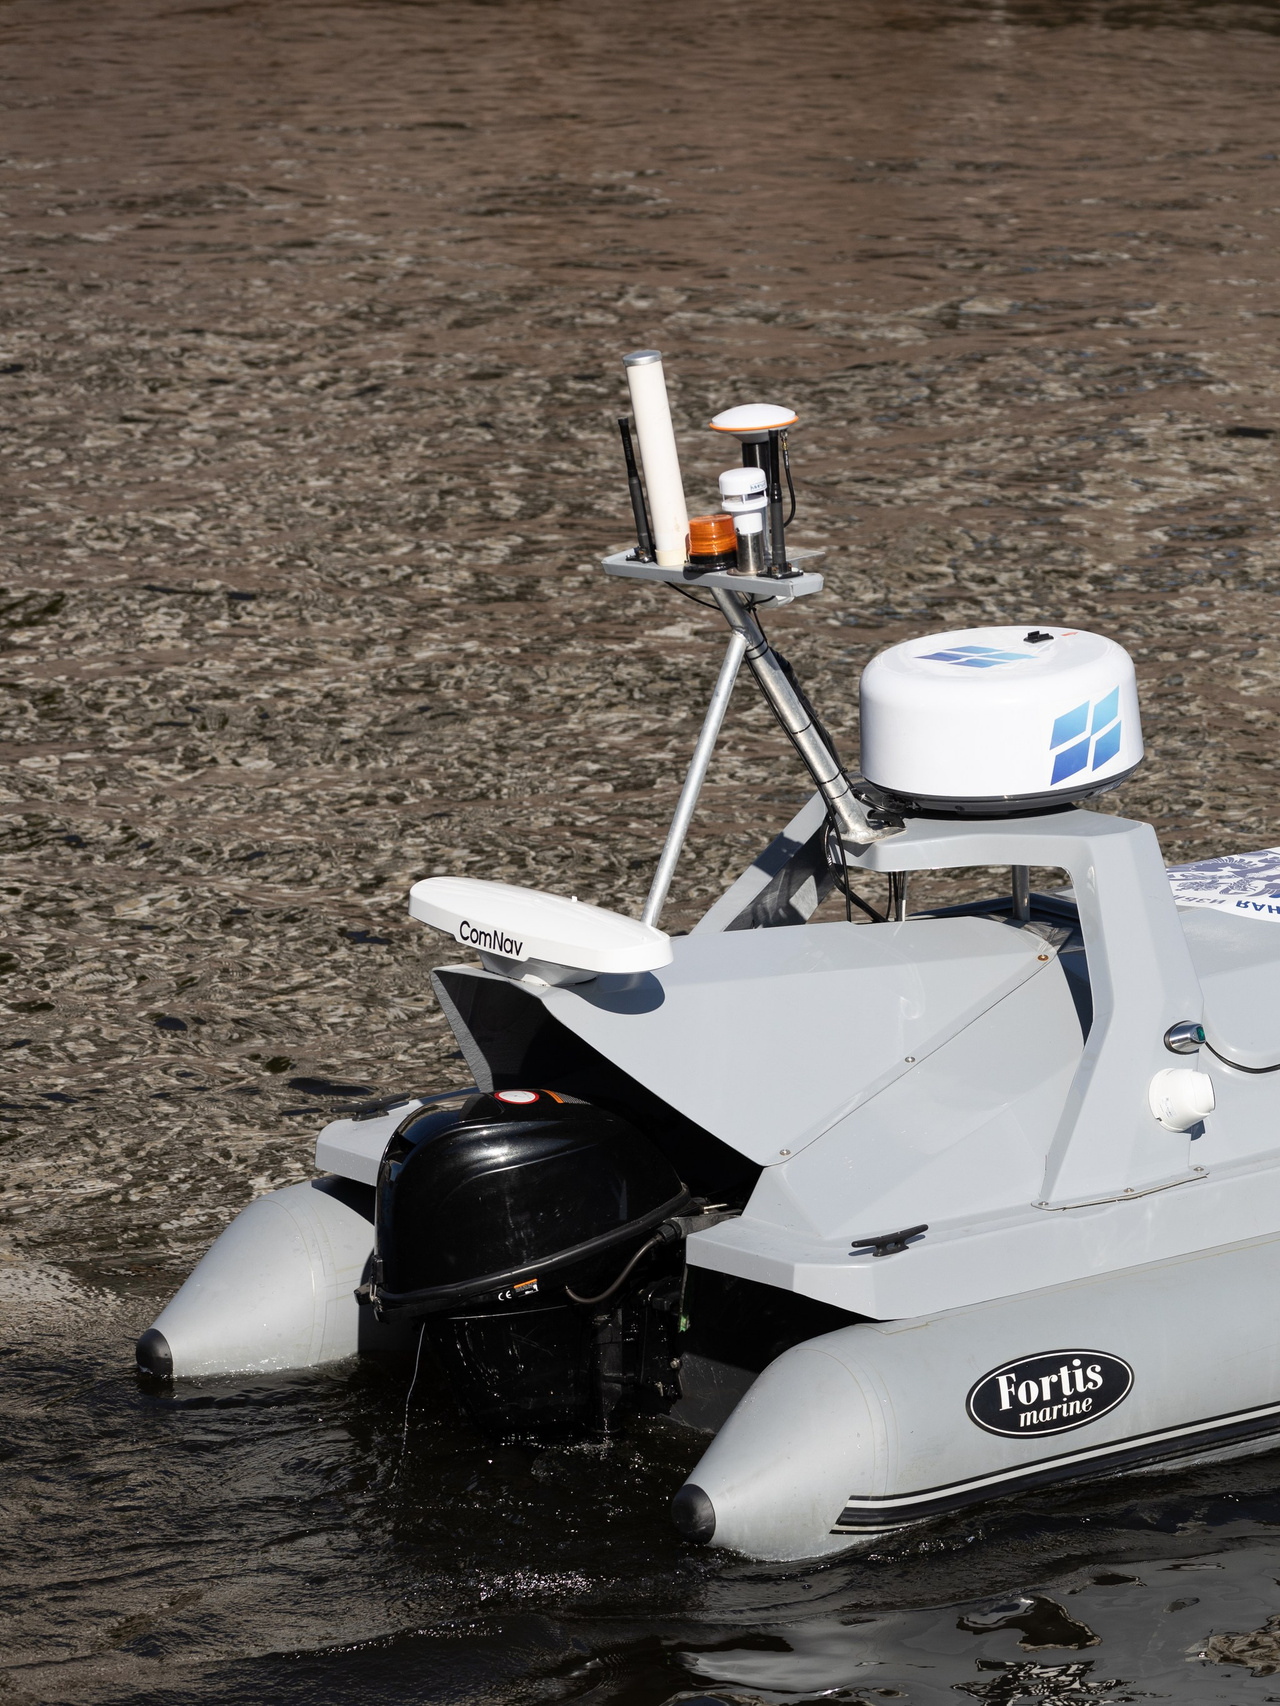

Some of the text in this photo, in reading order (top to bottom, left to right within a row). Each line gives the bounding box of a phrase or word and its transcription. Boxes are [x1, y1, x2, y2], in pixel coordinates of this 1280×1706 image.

[459, 920, 523, 956] ComNav
[996, 1358, 1104, 1412] Fortis
[1019, 1397, 1093, 1428] marine
